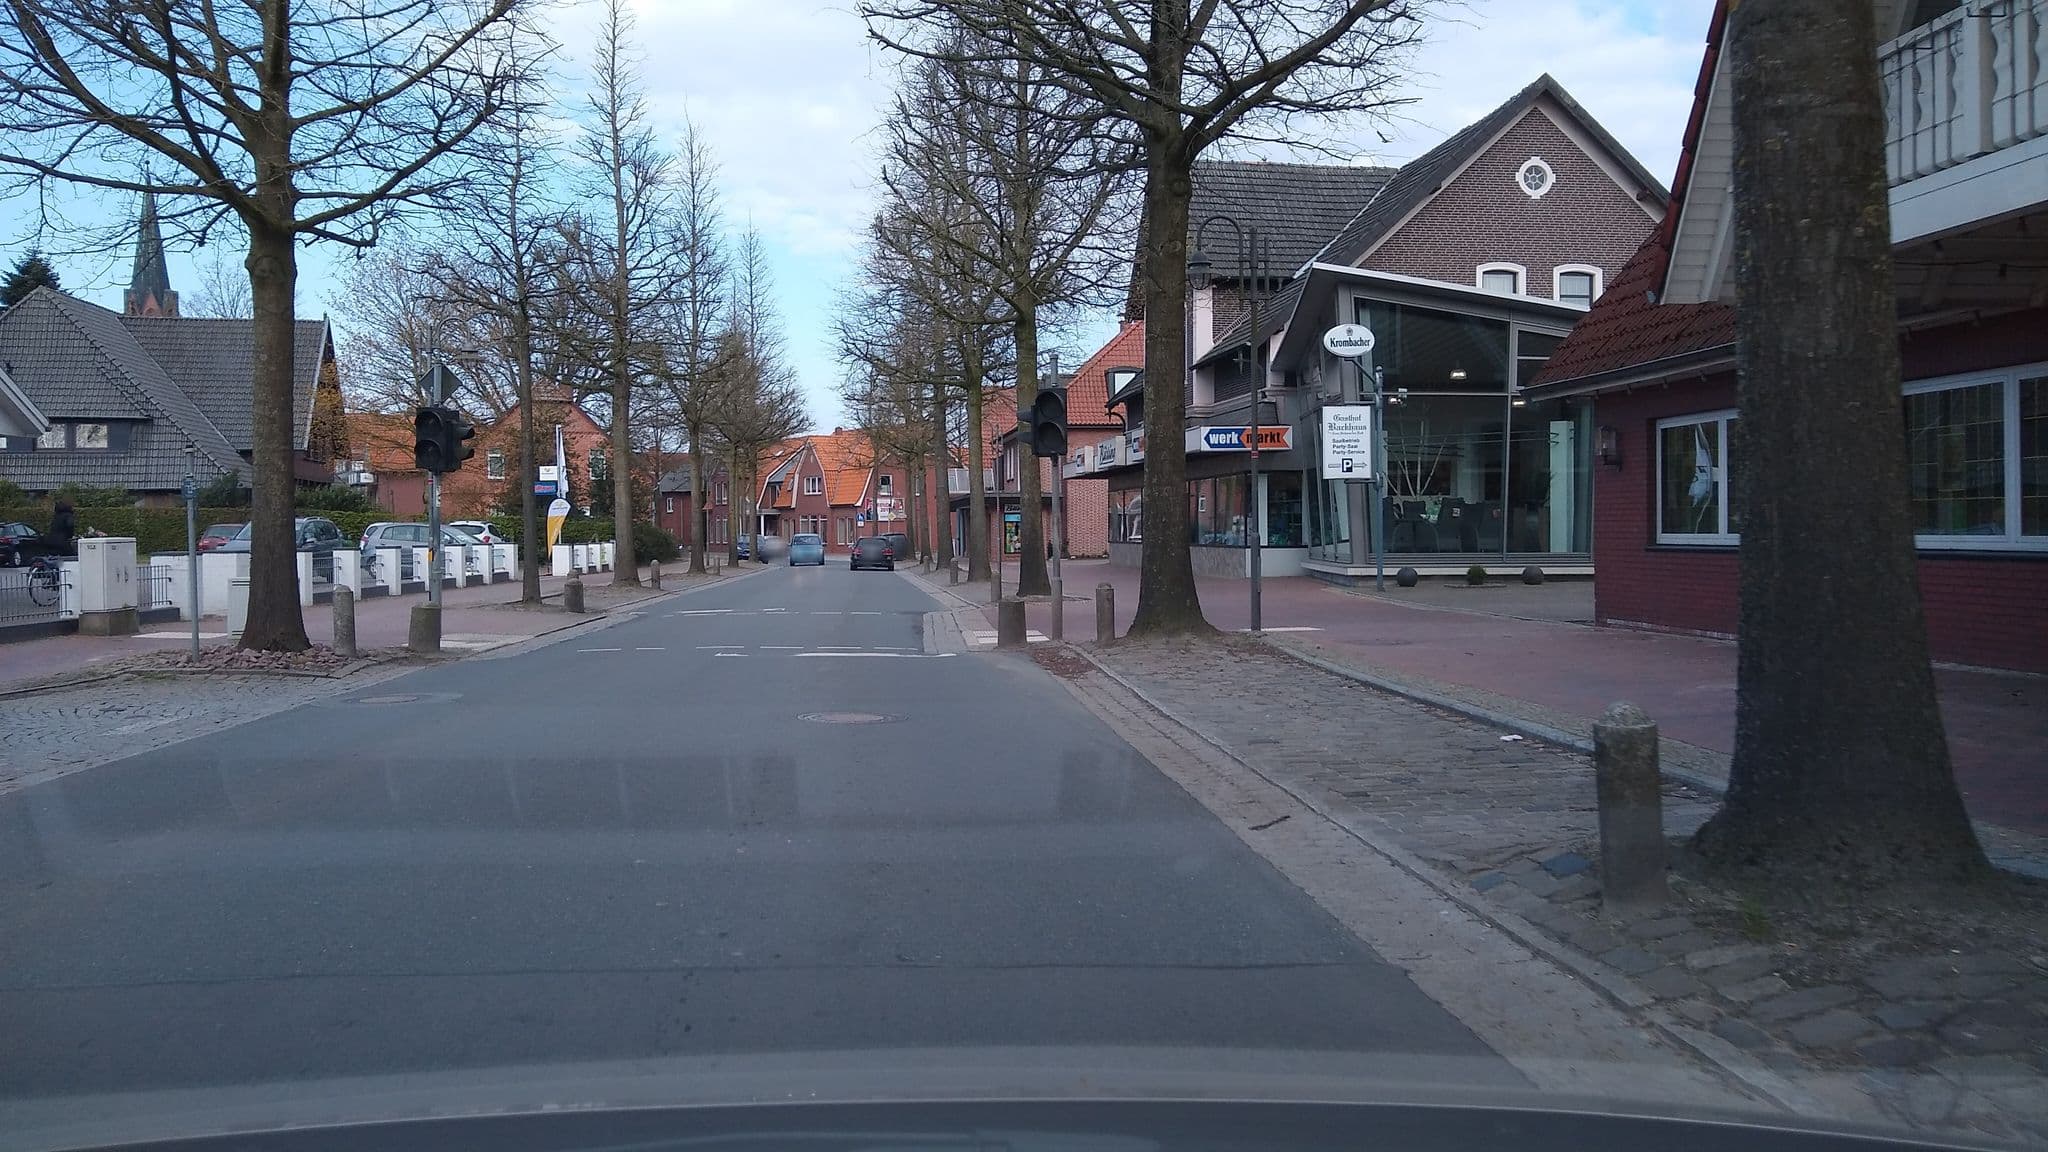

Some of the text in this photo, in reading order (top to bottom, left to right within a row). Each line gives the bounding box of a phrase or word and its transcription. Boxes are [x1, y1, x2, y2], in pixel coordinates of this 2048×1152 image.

[1330, 337, 1370, 347] Krombacher
[1209, 432, 1239, 444] werk
[1343, 459, 1352, 471] P
